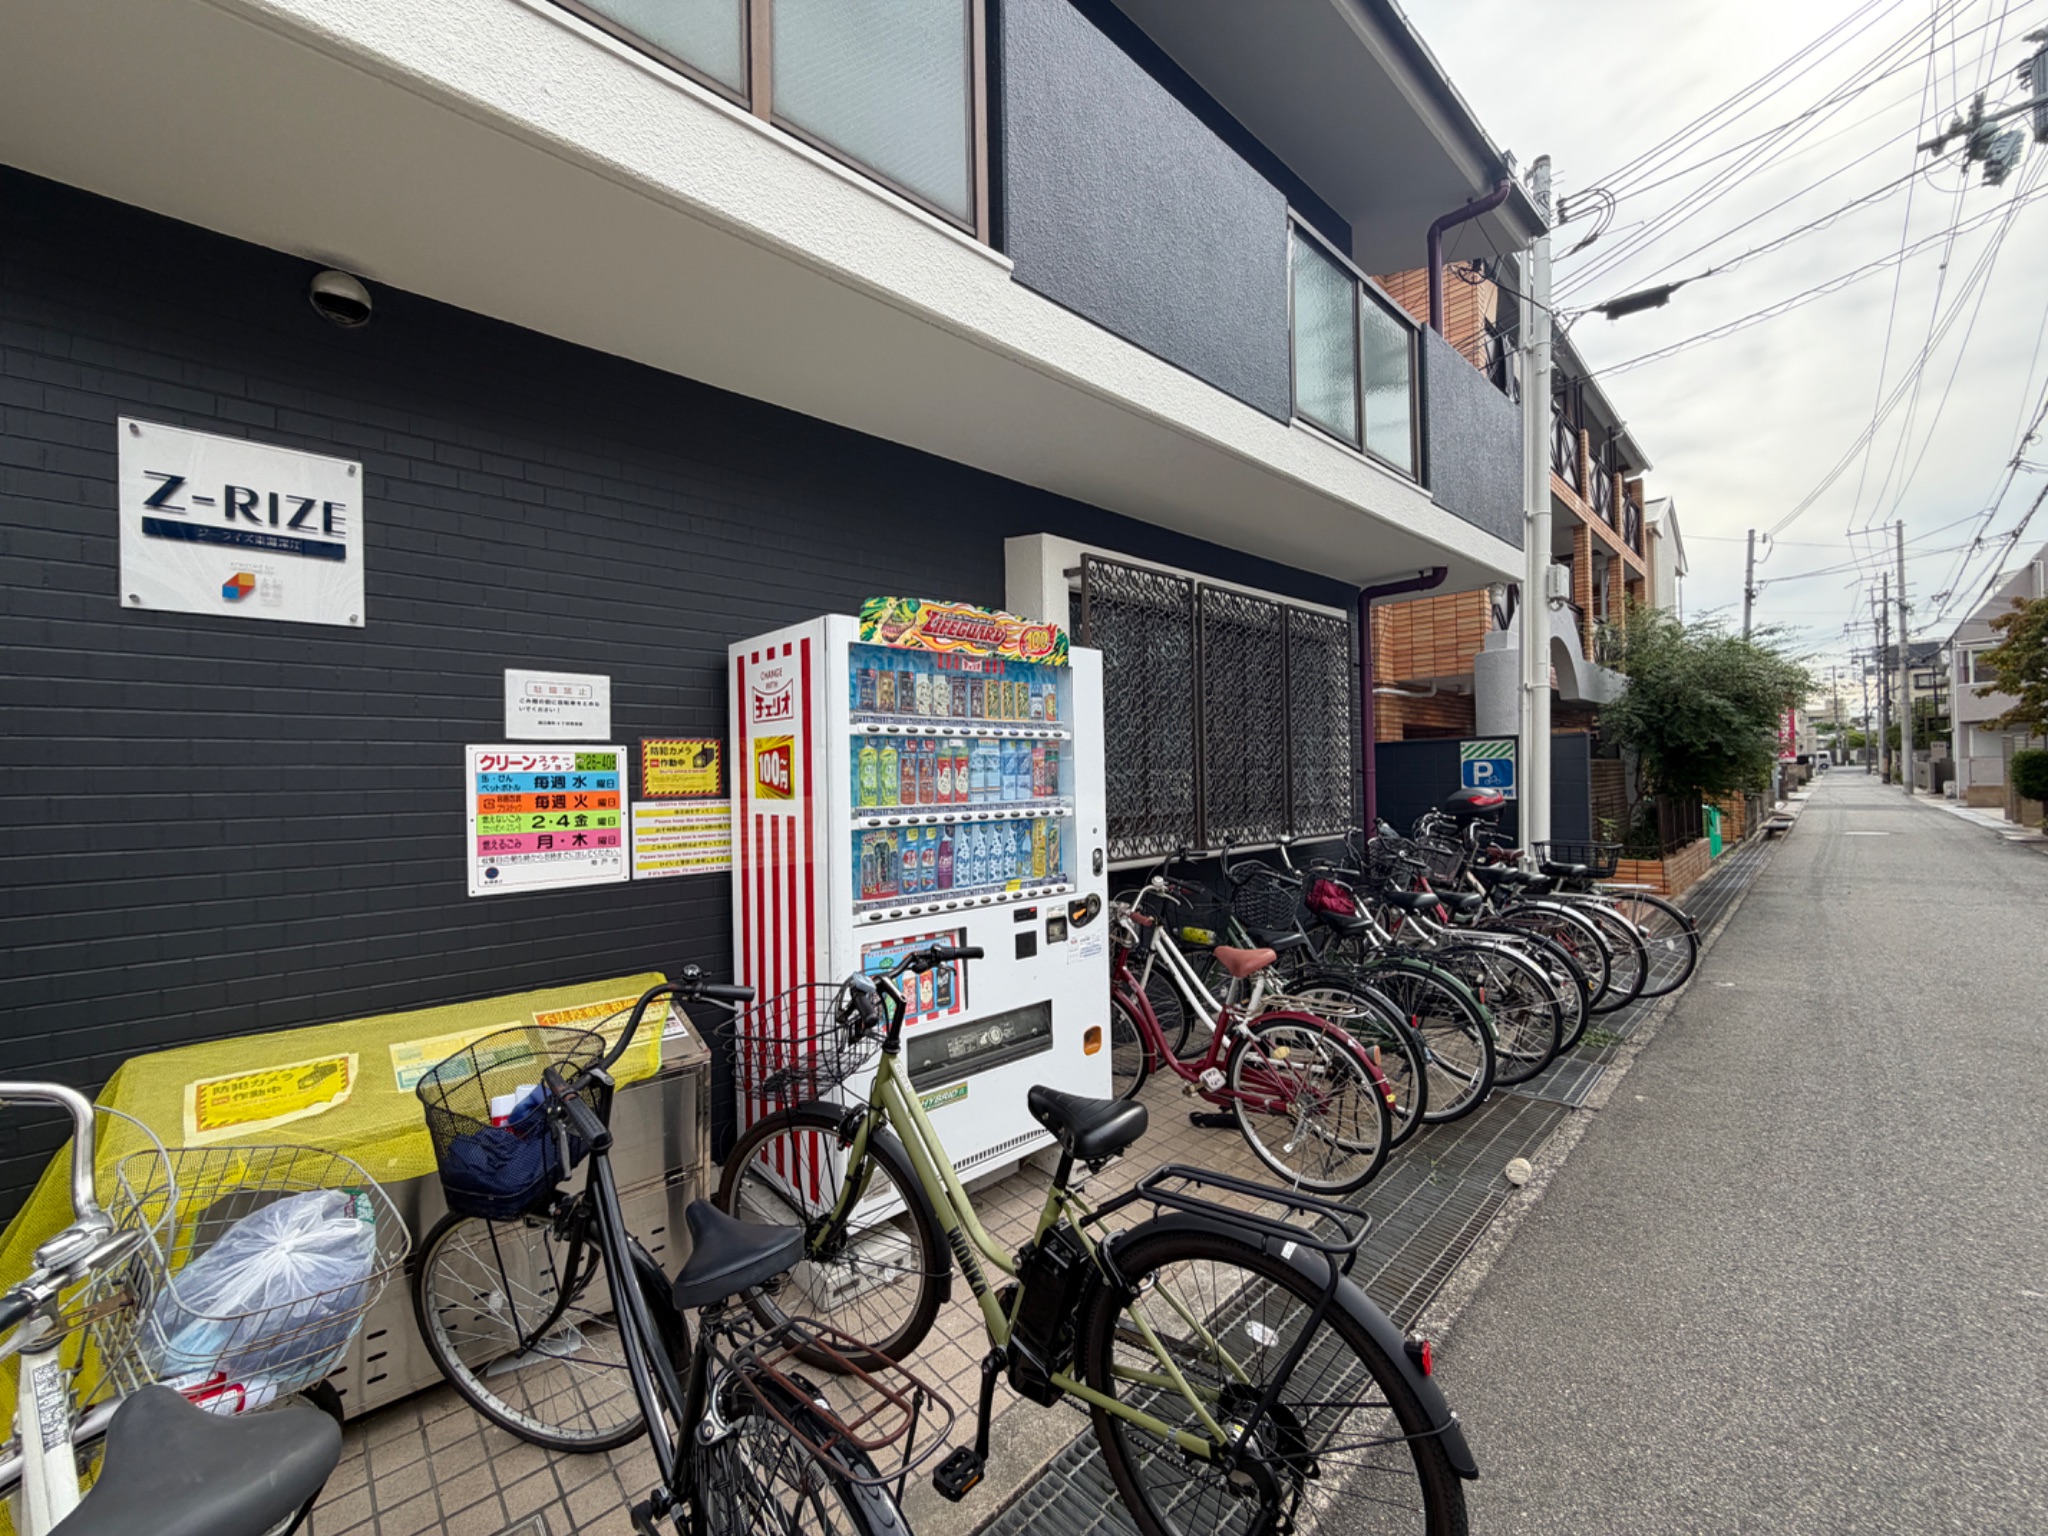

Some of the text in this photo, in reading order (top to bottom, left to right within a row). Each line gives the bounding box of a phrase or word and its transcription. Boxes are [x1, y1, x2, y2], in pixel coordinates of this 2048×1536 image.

[143, 470, 346, 536] Z-RIZE
[921, 611, 1007, 644] LIFEGUARD
[760, 667, 782, 680] CHANGE
[755, 690, 791, 719] チェリオ
[650, 746, 692, 756] 防犯カメラ
[479, 754, 537, 771] クリーン
[1473, 761, 1494, 785] P
[534, 775, 566, 790] 毎週
[572, 775, 588, 789] 水
[535, 794, 567, 809] 毎週
[574, 794, 588, 808] 火
[574, 813, 589, 828] 金
[212, 1072, 294, 1096] 防犯カメラ
